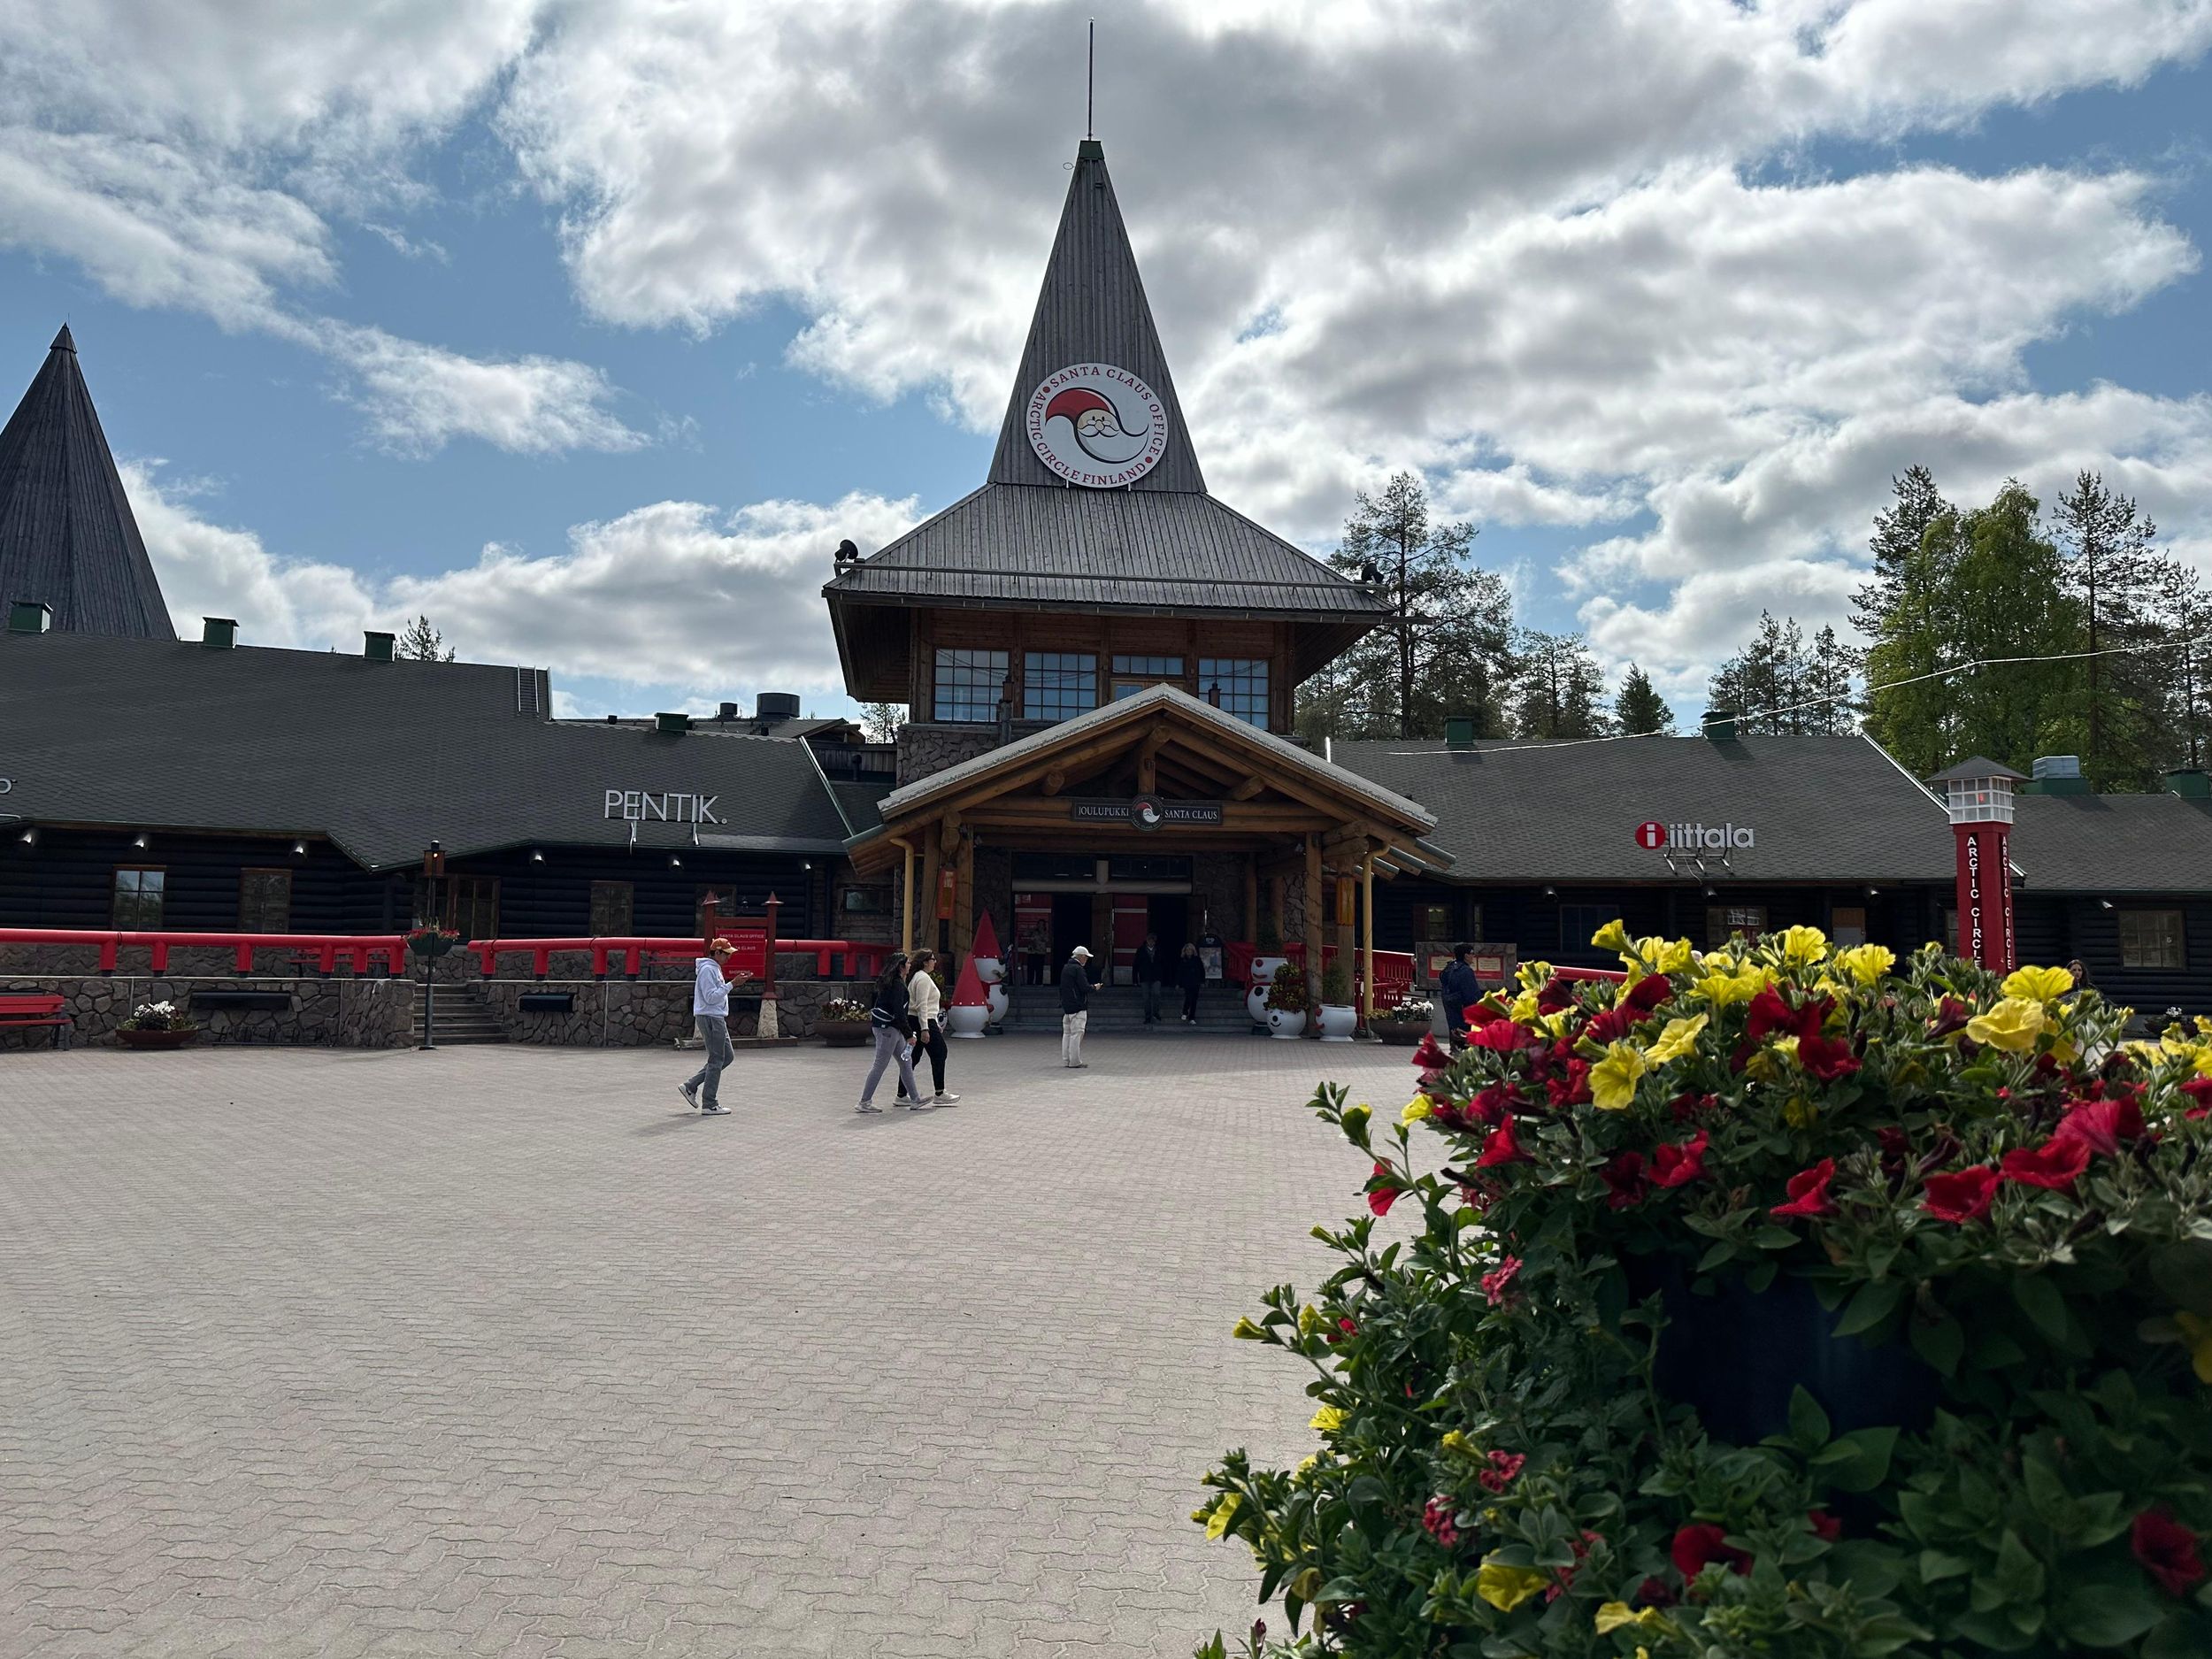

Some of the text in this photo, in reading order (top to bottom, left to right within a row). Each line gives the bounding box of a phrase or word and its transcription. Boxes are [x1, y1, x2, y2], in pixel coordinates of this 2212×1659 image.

[1029, 391, 1146, 485] ARCTIC CIRCLE FINLAND
[1049, 366, 1164, 456] SANTA CLAUS OFFICE
[1078, 806, 1129, 817] JOULUPUKKI
[1164, 809, 1217, 820] SANTA CLAUS
[1669, 823, 1755, 848] iittala
[1967, 836, 1982, 969] ARCTIC CIRCLE
